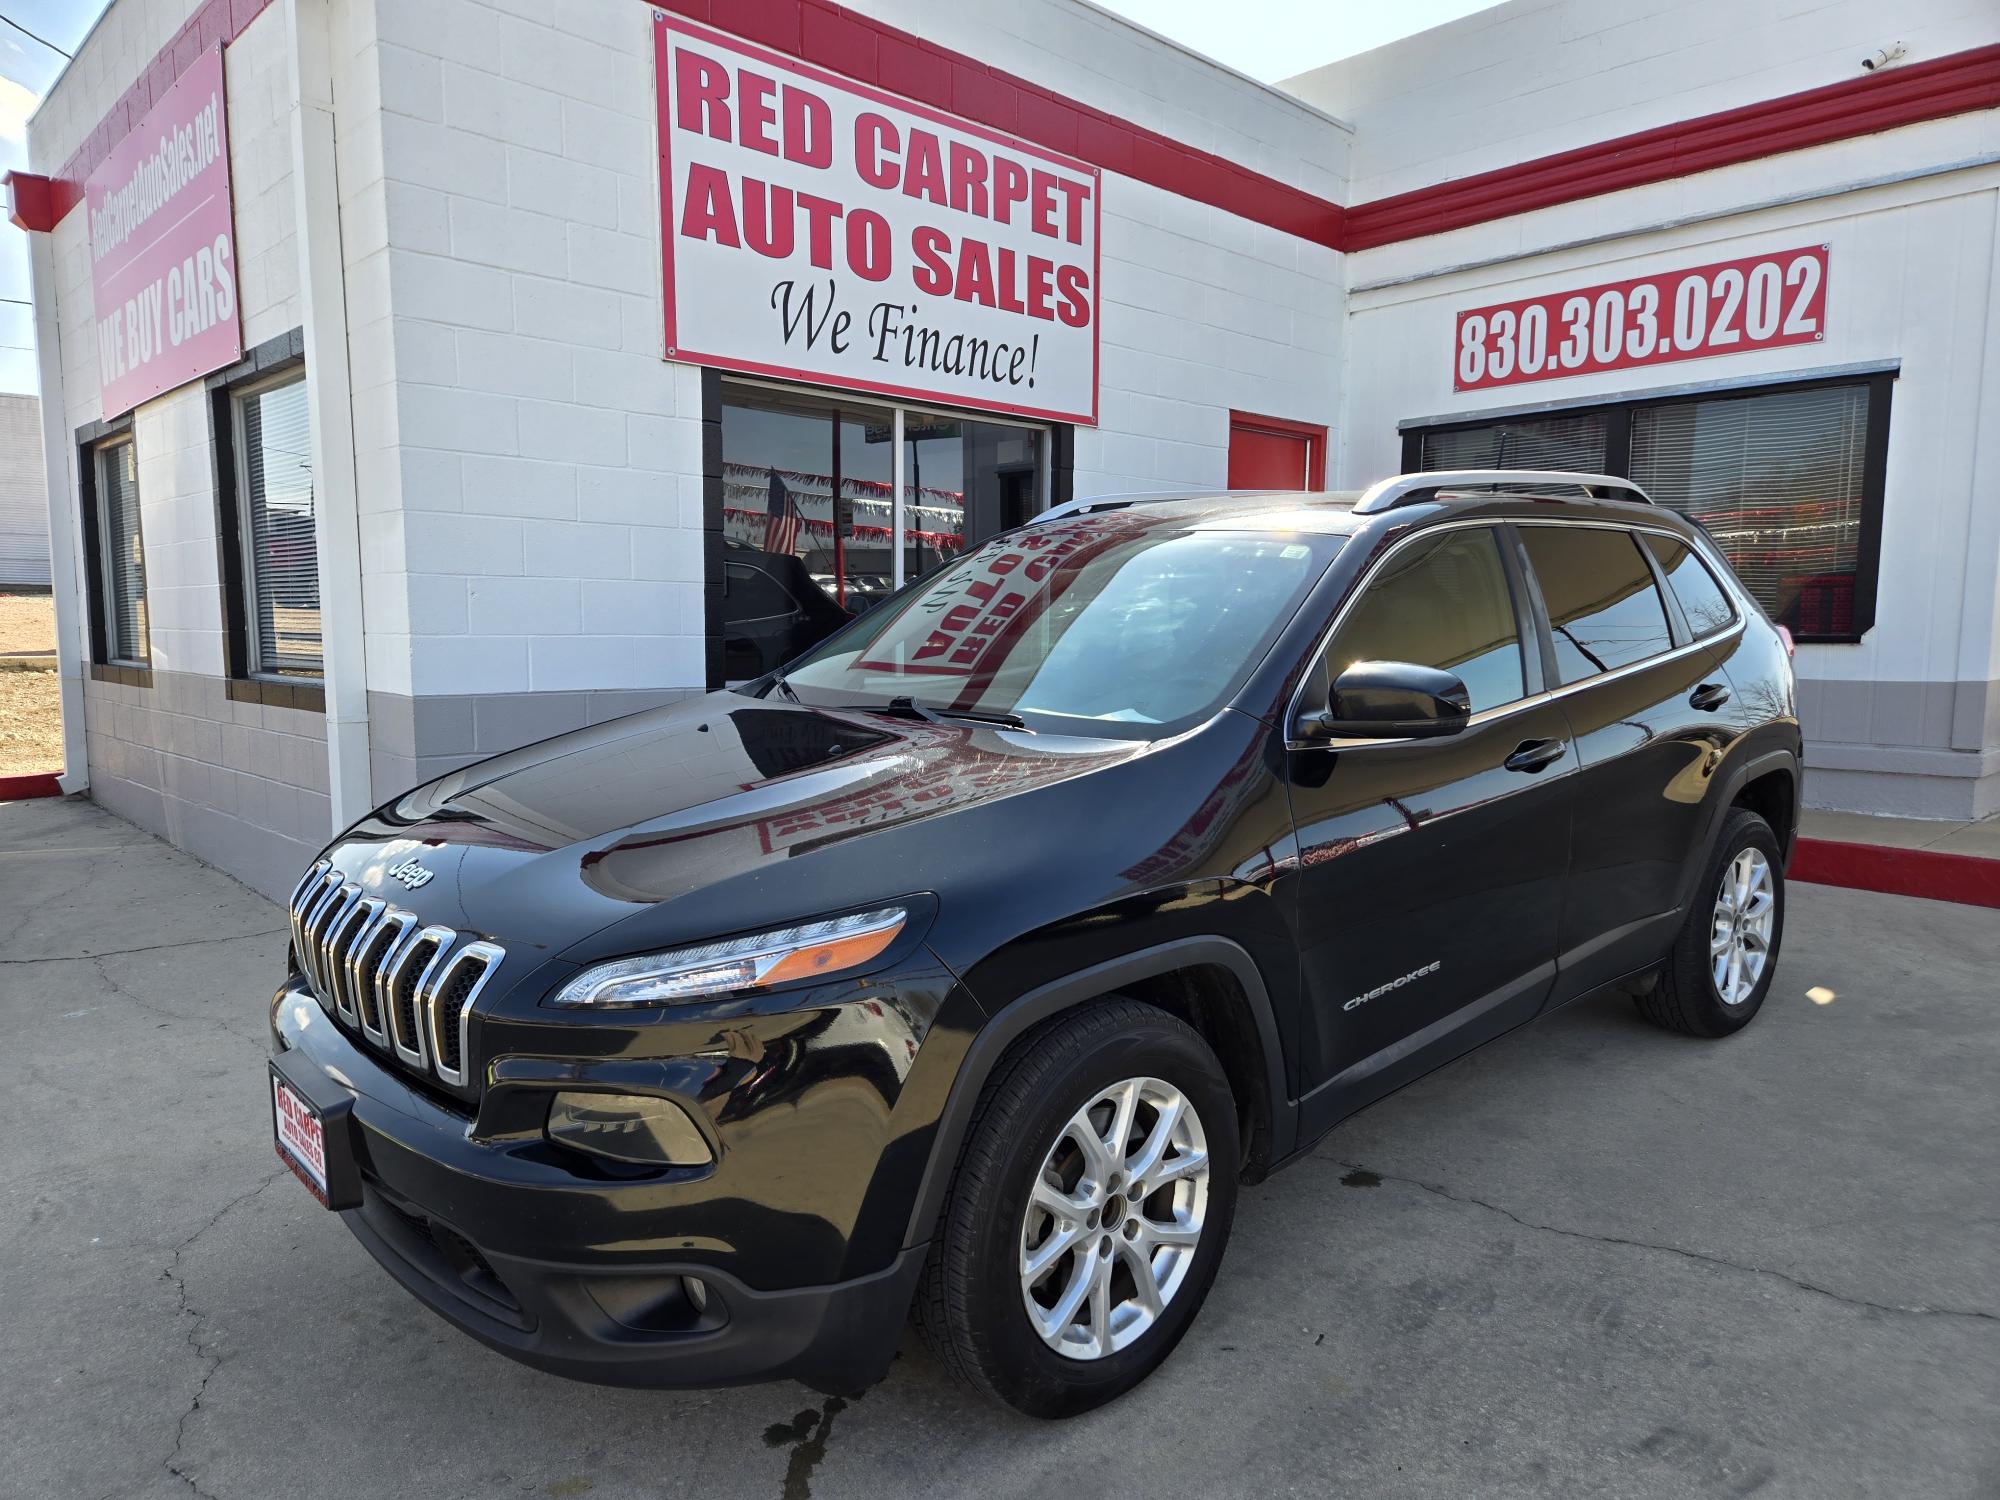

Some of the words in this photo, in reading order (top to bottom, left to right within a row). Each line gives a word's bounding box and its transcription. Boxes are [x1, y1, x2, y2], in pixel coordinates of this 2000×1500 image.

[91, 90, 220, 264] RedCarpetAutoSales.net
[675, 46, 832, 170] RED
[854, 112, 1091, 246] CARPET
[680, 161, 892, 282] AUTO
[911, 225, 1091, 328] SALES
[97, 306, 127, 388] WE
[124, 277, 163, 371] BUY
[167, 233, 234, 346] CARS
[770, 278, 852, 355] We
[868, 301, 1039, 389] Finance!
[1458, 255, 1822, 384] 830.303.0202
[388, 857, 435, 891] Jeep
[1343, 960, 1441, 1012] CHEROKEE
[277, 1086, 293, 1120] RED
